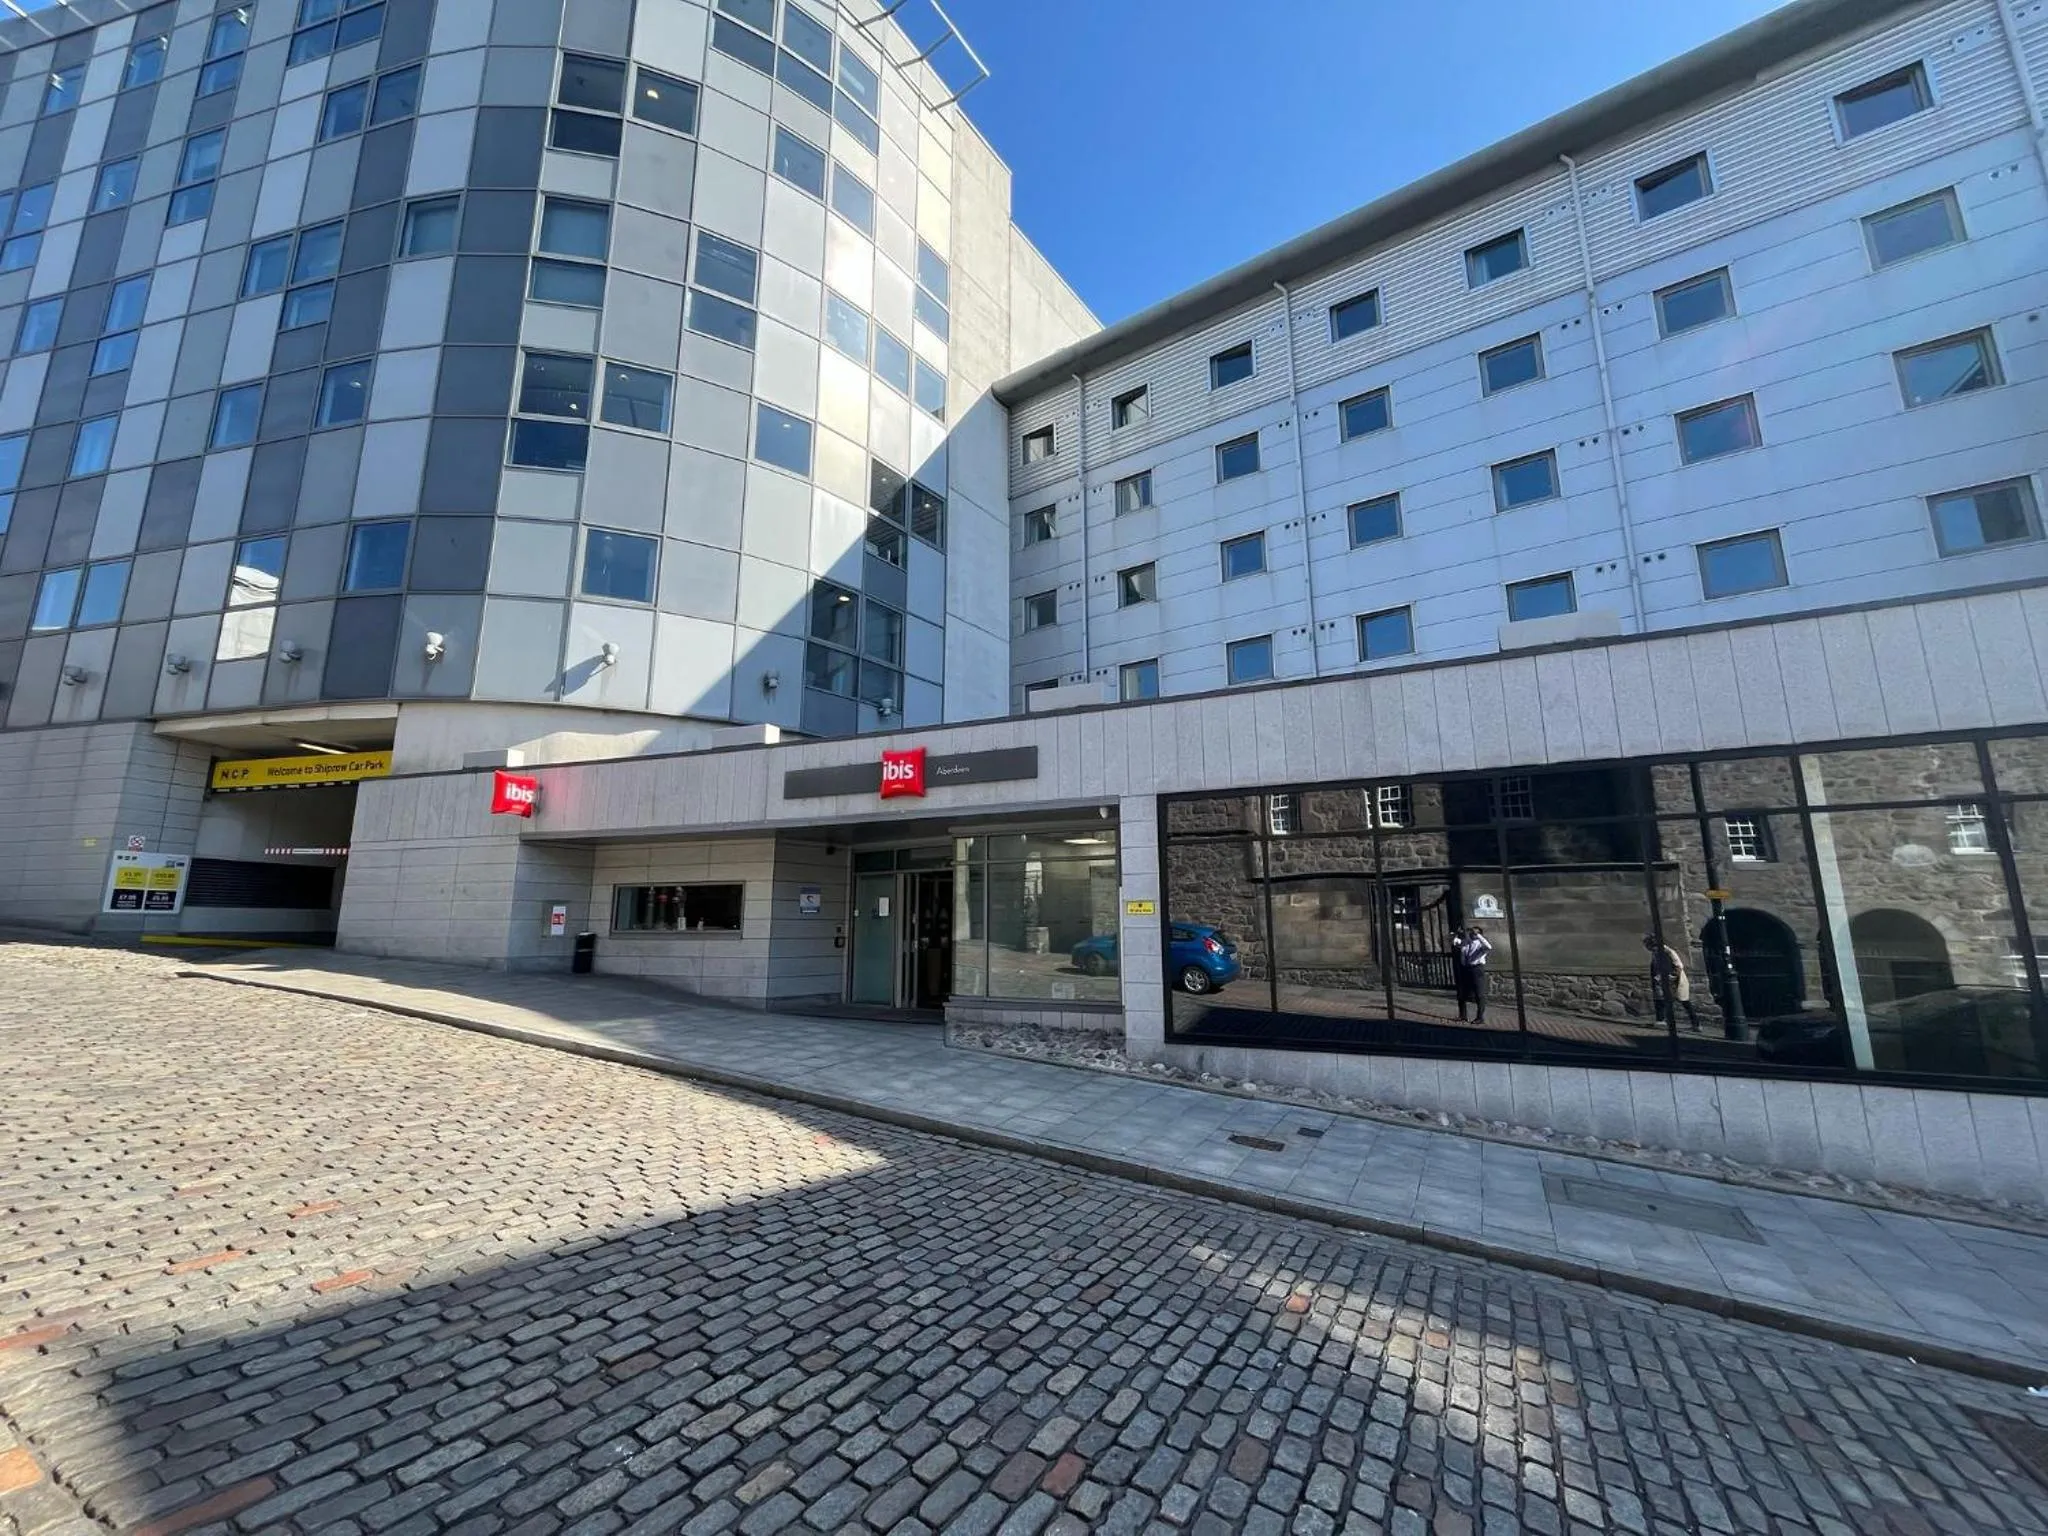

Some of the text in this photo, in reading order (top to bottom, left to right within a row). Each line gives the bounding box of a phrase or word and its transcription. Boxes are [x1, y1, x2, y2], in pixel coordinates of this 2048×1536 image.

[267, 767, 303, 777] Welcome
[304, 766, 314, 775] to
[349, 761, 363, 771] Car
[365, 759, 384, 770] Park
[883, 760, 914, 780] ibis
[505, 782, 534, 803] ibis
